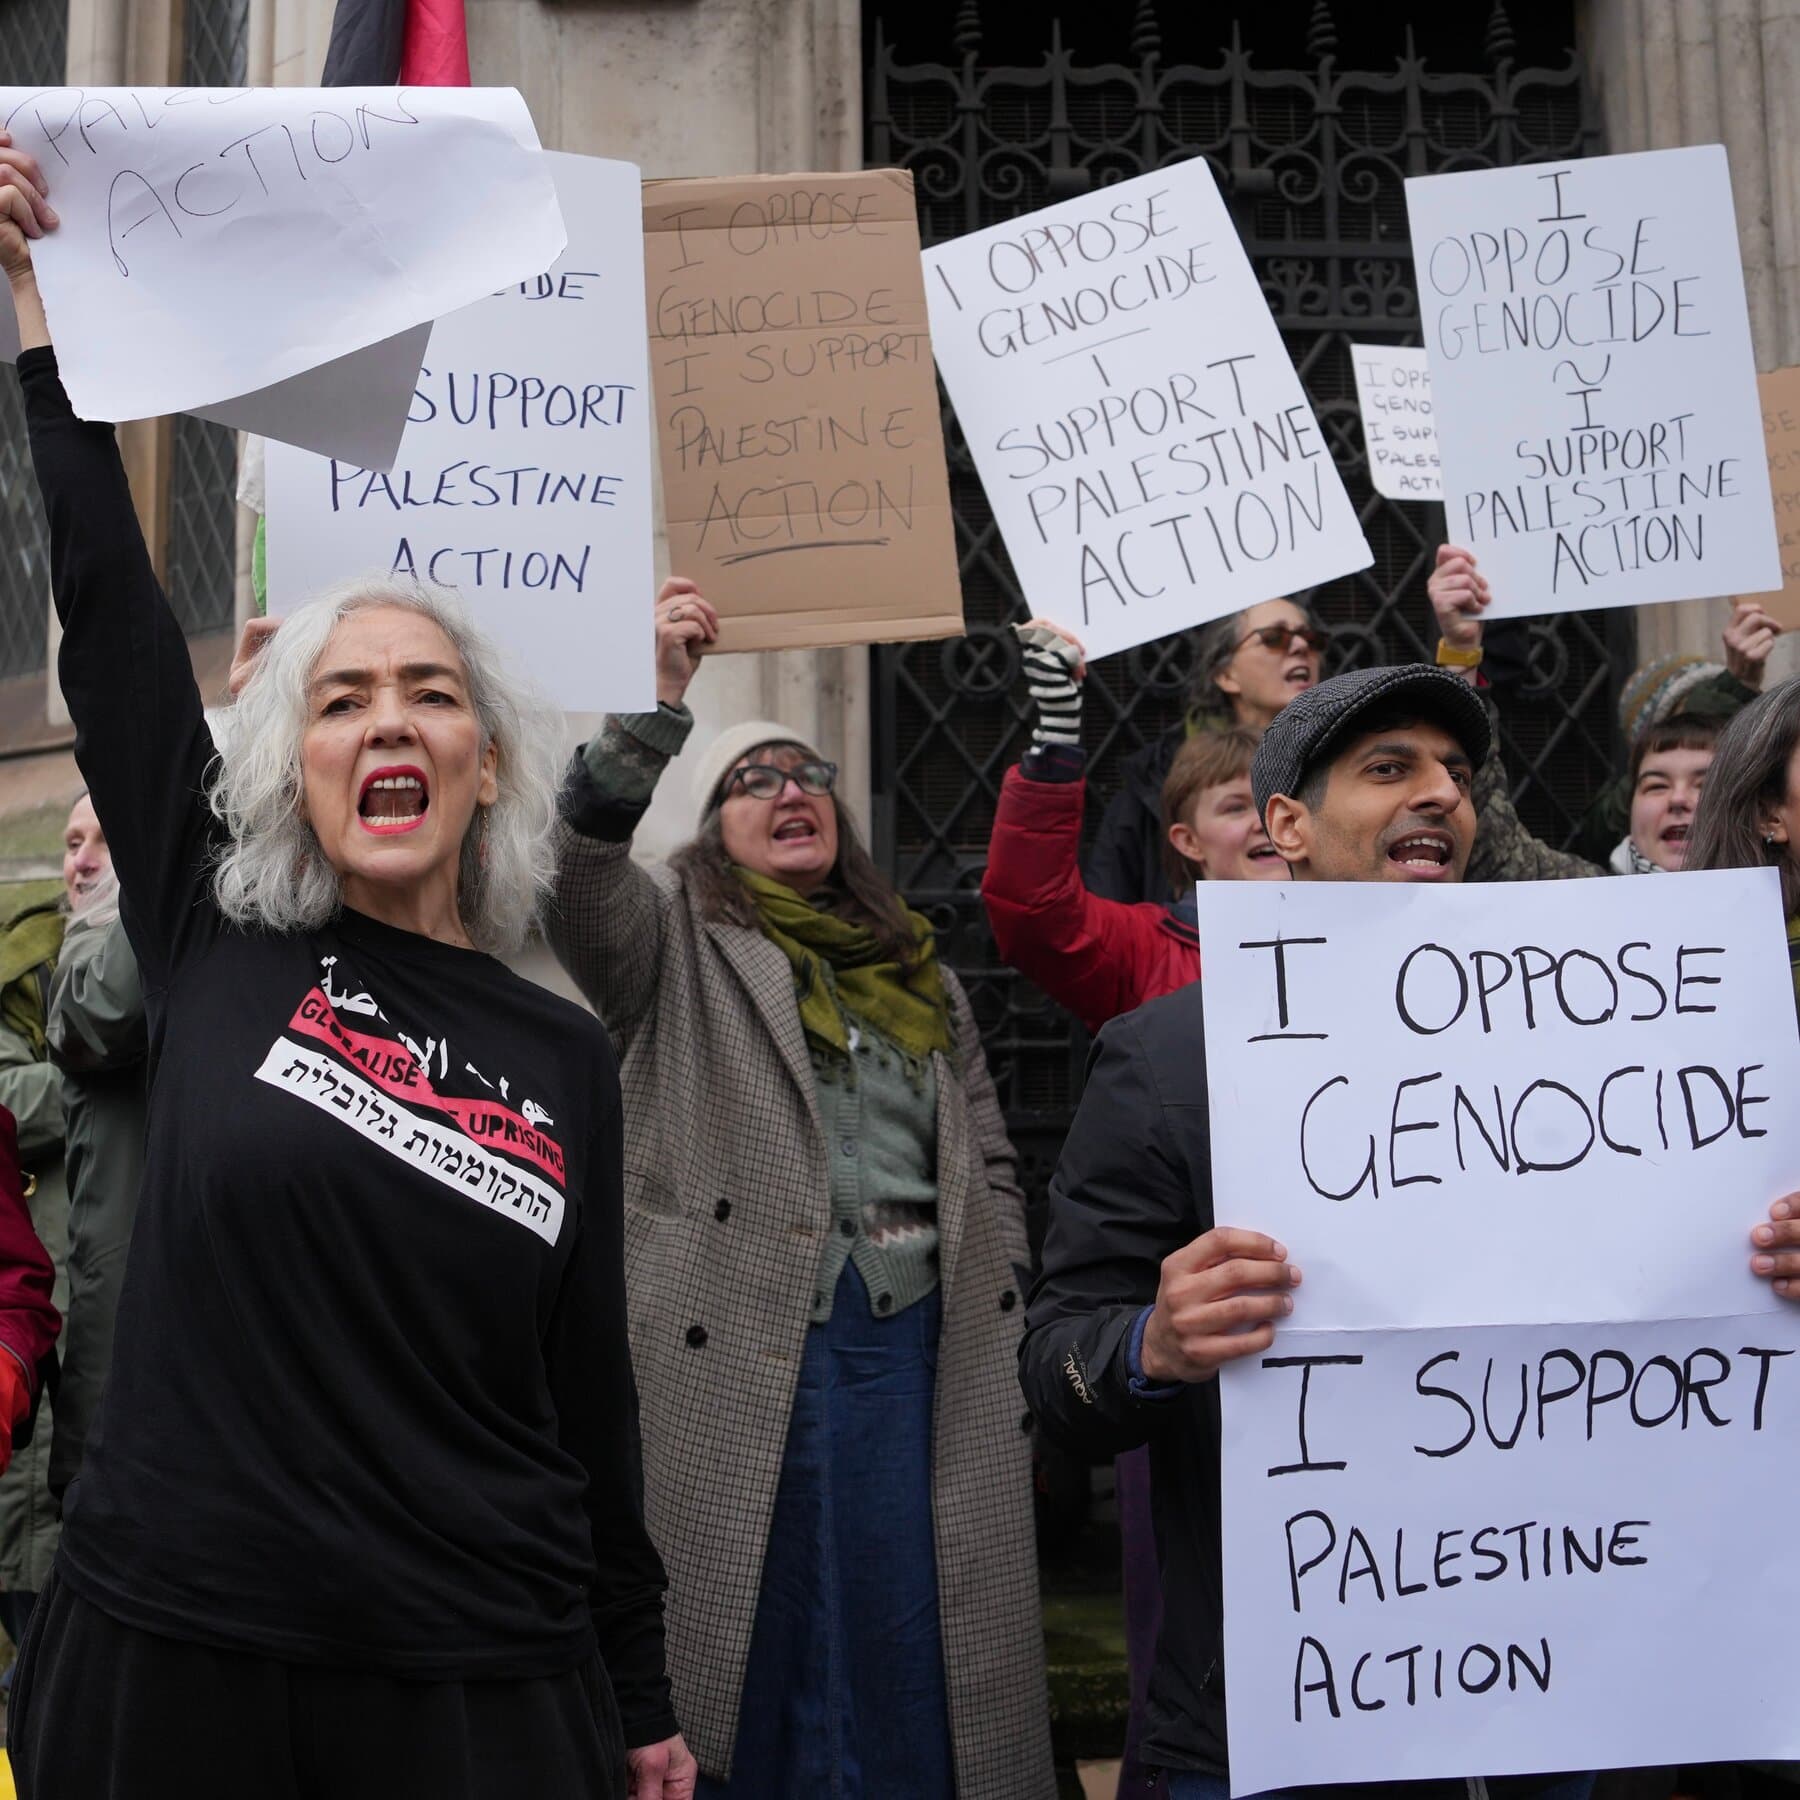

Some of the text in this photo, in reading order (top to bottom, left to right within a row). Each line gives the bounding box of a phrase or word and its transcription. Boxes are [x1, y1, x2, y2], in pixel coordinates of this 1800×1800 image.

[108, 88, 419, 277] ACTION
[1537, 171, 1587, 222] I
[663, 190, 888, 272] I OPPOSE
[936, 189, 1179, 311] I OPPOSE
[1429, 216, 1666, 297] OPPOSE
[656, 285, 899, 347] GENOCIDE
[978, 242, 1217, 358] GENOCIDE
[1438, 276, 1711, 360] GENOCIDE
[407, 367, 636, 430] SUPPORT
[665, 334, 930, 396] I SUPPORT
[1092, 354, 1111, 387] I
[1360, 362, 1385, 387] I
[669, 405, 914, 472] PALESTINE
[996, 355, 1256, 479] SUPPORT
[1367, 422, 1438, 442] I SUP
[1516, 413, 1695, 480] SUPPORT
[1566, 388, 1605, 431] I
[331, 459, 624, 512] PALESTINE
[696, 465, 913, 552] ACTION
[1028, 405, 1321, 544] PALESTINE
[1464, 459, 1742, 542] PALESTINE
[389, 538, 591, 593] ACTION
[1083, 462, 1323, 626] ACTION
[1552, 513, 1703, 594] ACTION
[1239, 937, 1726, 1043] I OPPOSE
[469, 1112, 564, 1173] UPRISING
[1300, 1064, 1770, 1201] GENOCIDE
[403, 1129, 552, 1223] התקוממות
[1261, 1346, 1796, 1478] I SUPPORT
[1286, 1510, 1652, 1613] PALESTINE
[1295, 1636, 1552, 1723] ACTION
